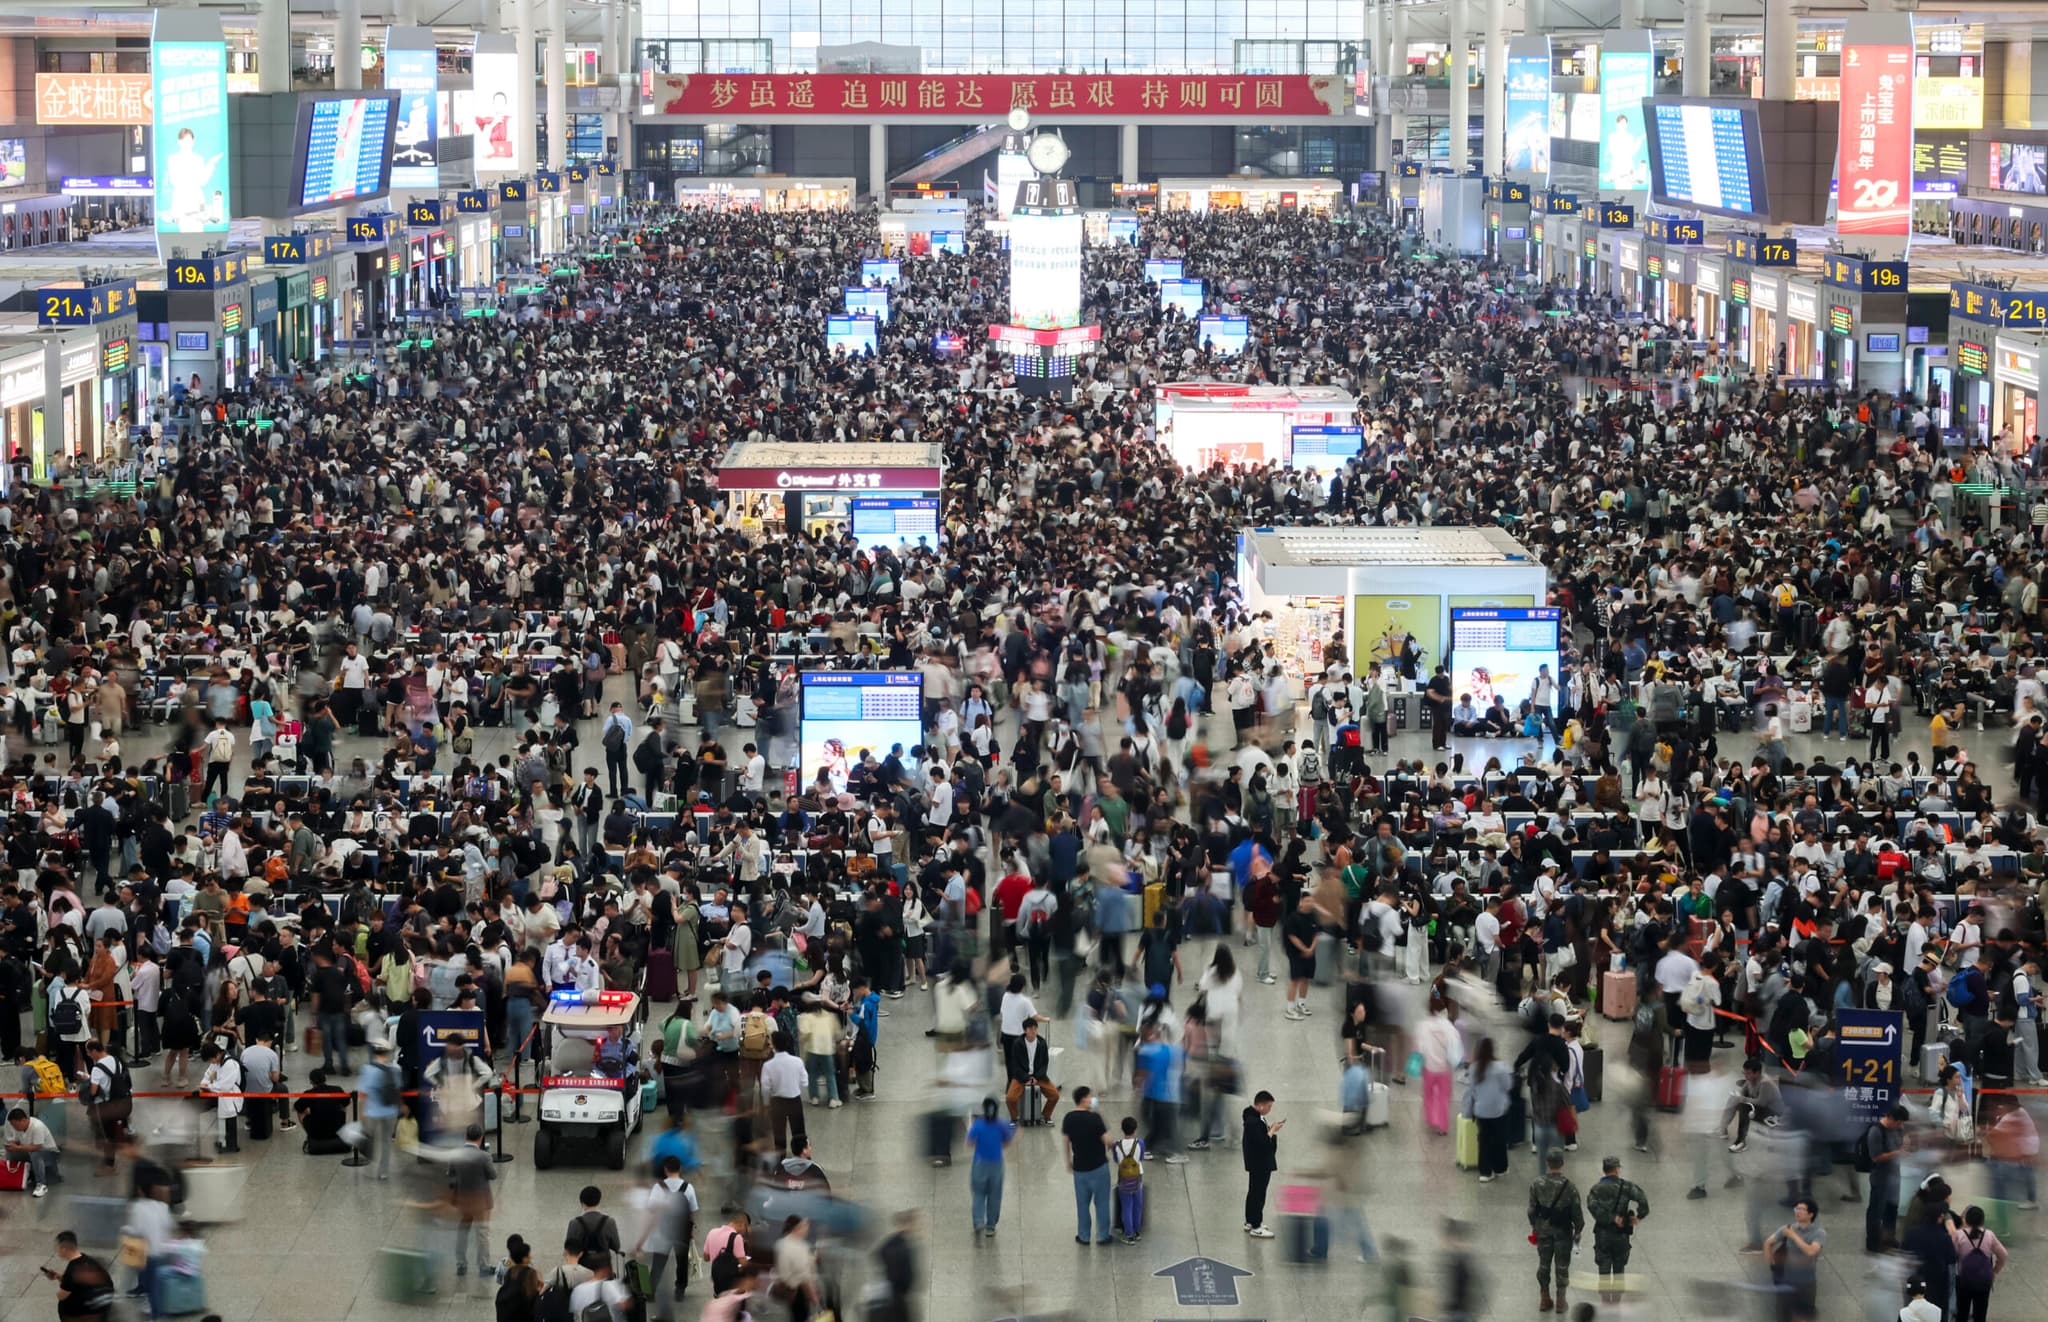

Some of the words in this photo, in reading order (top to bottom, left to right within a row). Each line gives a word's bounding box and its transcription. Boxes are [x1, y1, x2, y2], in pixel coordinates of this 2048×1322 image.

[43, 78, 143, 120] 金蛇柚福
[711, 80, 815, 108] 梦虽遥
[841, 80, 983, 108] 追则能达
[1010, 80, 1115, 108] 愿虽艰
[1141, 80, 1283, 109] 持则可圆
[541, 177, 553, 188] 7A
[571, 170, 583, 181] 5A
[506, 186, 519, 198] 9A
[1510, 188, 1523, 200] 9B
[463, 197, 482, 208] 11A
[1553, 199, 1572, 210] 11B
[413, 208, 435, 221] 13A
[1607, 210, 1629, 223] 13B
[352, 223, 377, 237] 15A
[1675, 225, 1698, 239] 15B
[271, 242, 299, 258] 17A
[1762, 245, 1791, 261] 17B
[175, 266, 206, 284] 19A
[1870, 269, 1901, 286] 19B
[46, 297, 84, 317] 21A
[2008, 299, 2047, 320] 21B
[838, 473, 882, 487] 外交官
[1842, 1058, 1893, 1083] 1-21
[1844, 1086, 1889, 1102] 检票口
